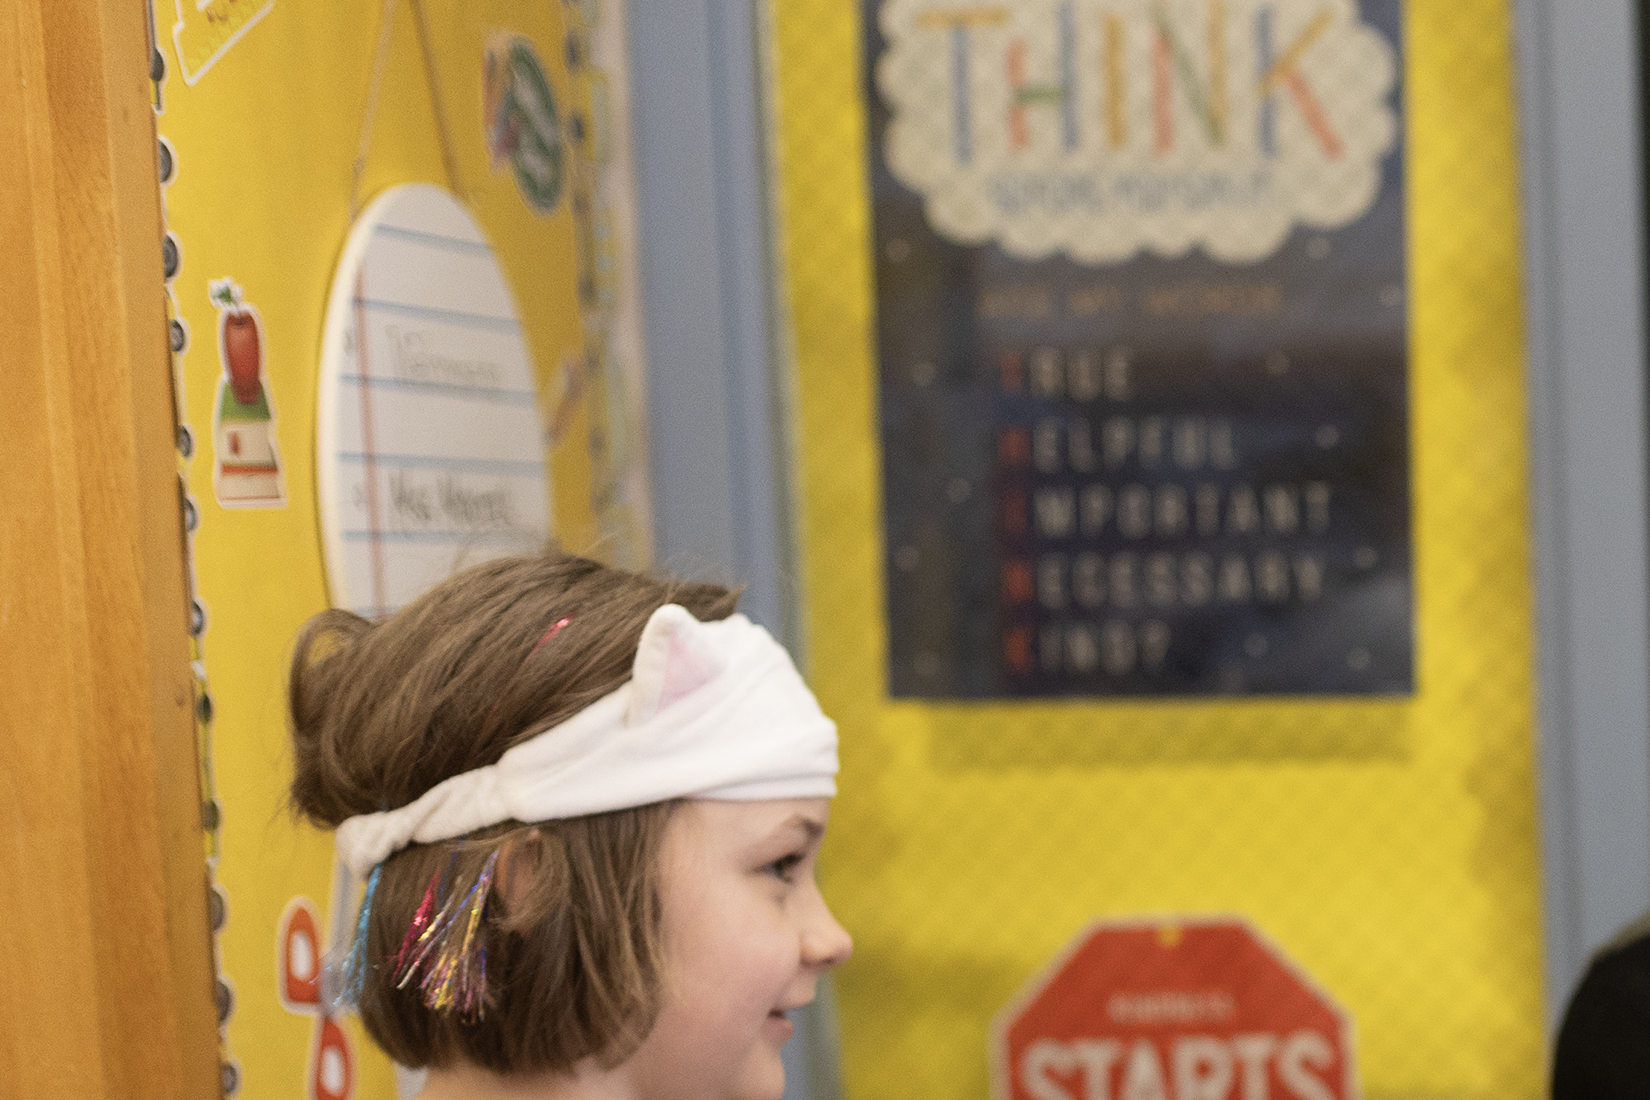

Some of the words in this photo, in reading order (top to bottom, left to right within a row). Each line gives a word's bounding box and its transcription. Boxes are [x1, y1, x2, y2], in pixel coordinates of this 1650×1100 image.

[914, 0, 1346, 167] THINK
[1001, 346, 1132, 400] TRUE
[1001, 416, 1237, 474] HELPFUL
[1005, 481, 1330, 538] IMPORTANT
[1004, 551, 1323, 609] NECESSARY
